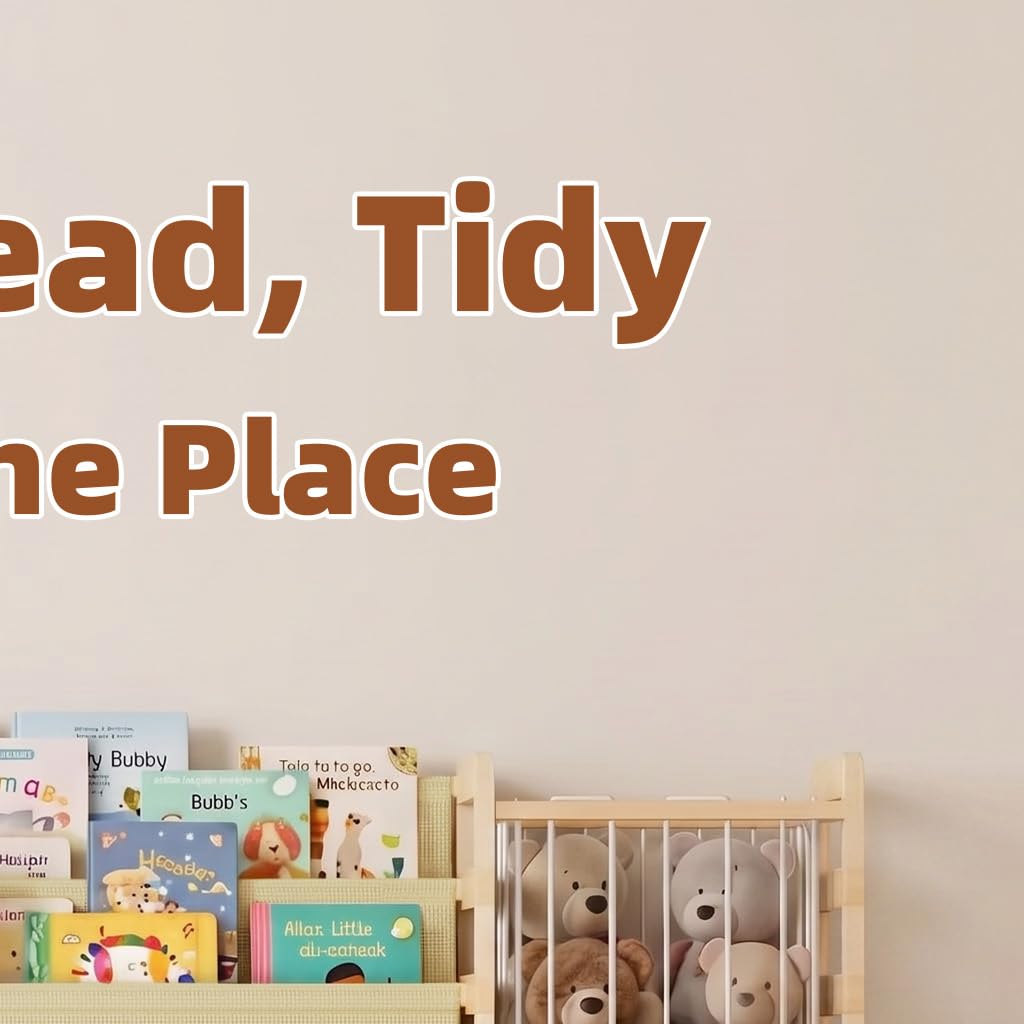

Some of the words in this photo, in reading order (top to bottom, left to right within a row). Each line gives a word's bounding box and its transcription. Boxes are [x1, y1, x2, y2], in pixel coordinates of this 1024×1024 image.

[111, 750, 167, 772] Bubby
[334, 760, 349, 773] to
[191, 793, 248, 810] Bubb's
